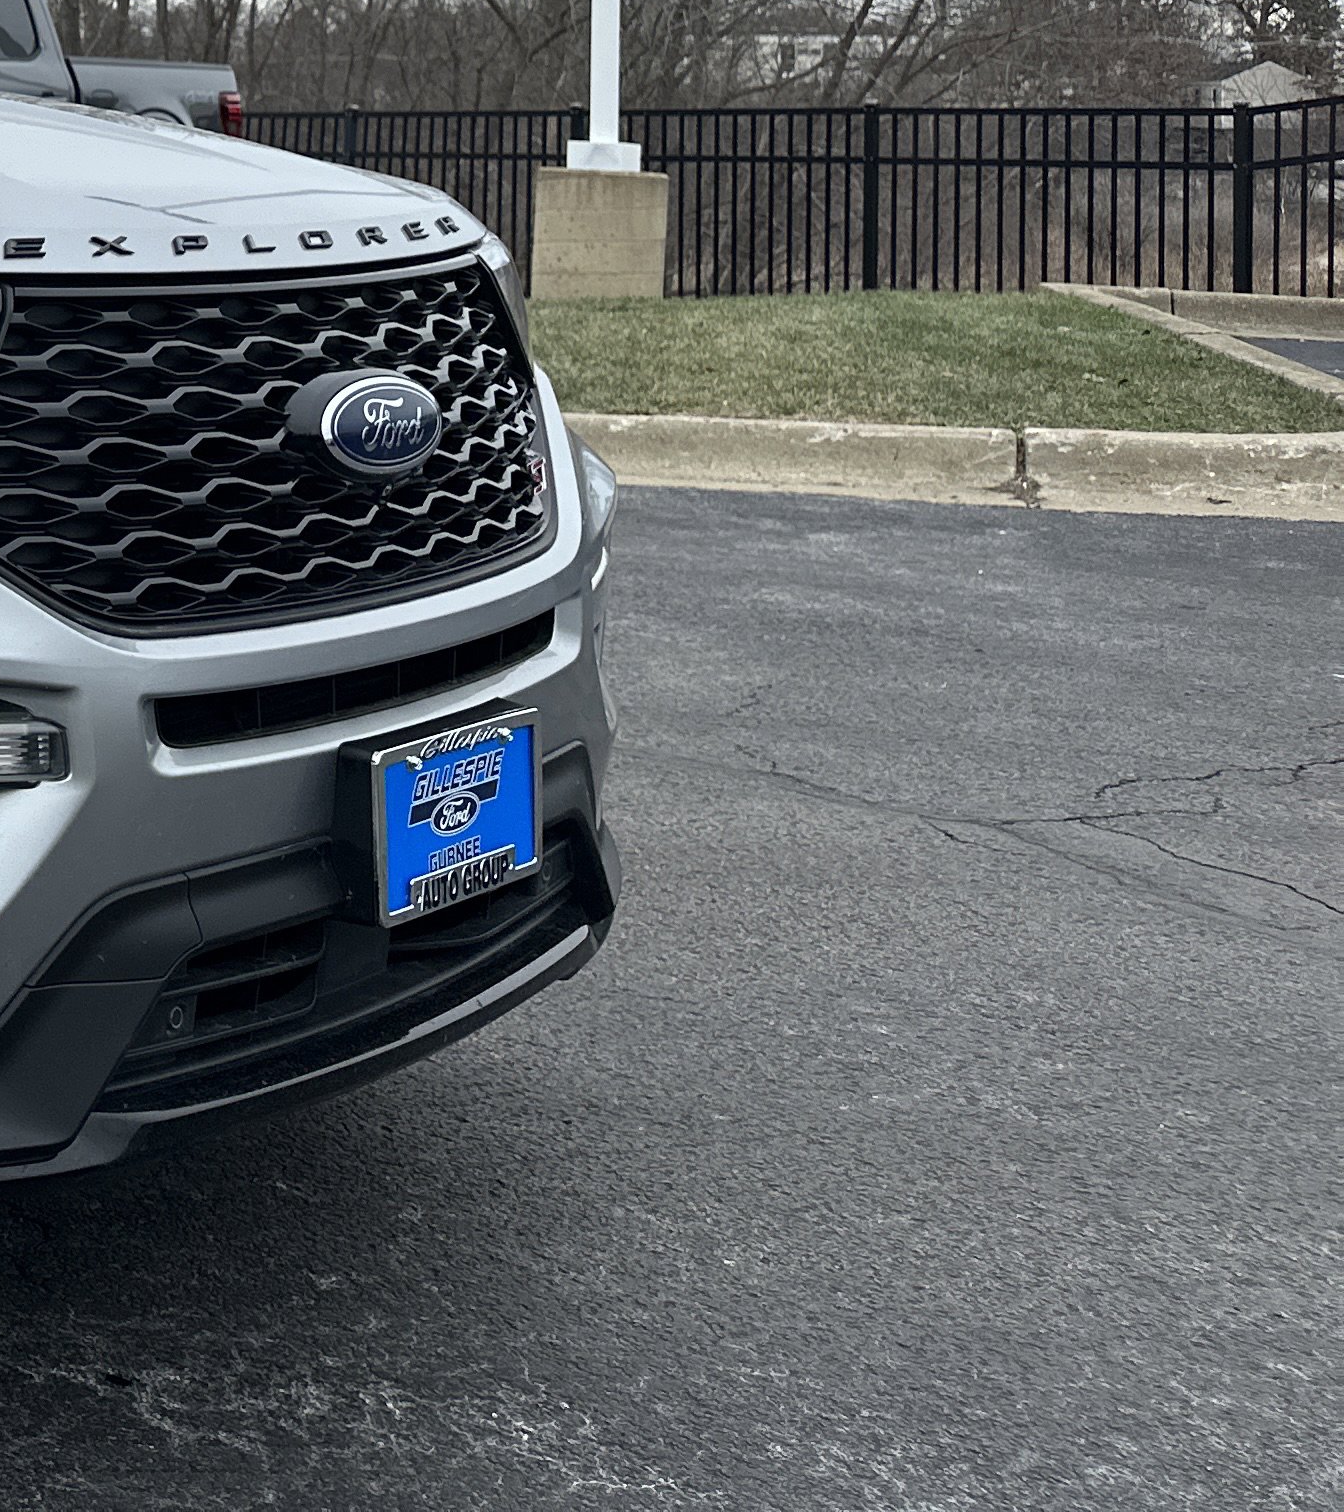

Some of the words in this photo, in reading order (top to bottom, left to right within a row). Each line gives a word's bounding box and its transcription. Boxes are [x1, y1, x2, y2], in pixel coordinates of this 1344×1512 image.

[3, 214, 462, 260] EXPLORER
[362, 396, 425, 453] Ford
[412, 748, 505, 803] GILLESPIE
[439, 797, 472, 830] Ford
[428, 835, 482, 873] GURNEE
[420, 870, 460, 912] AUTO
[462, 853, 510, 897] GROUP
